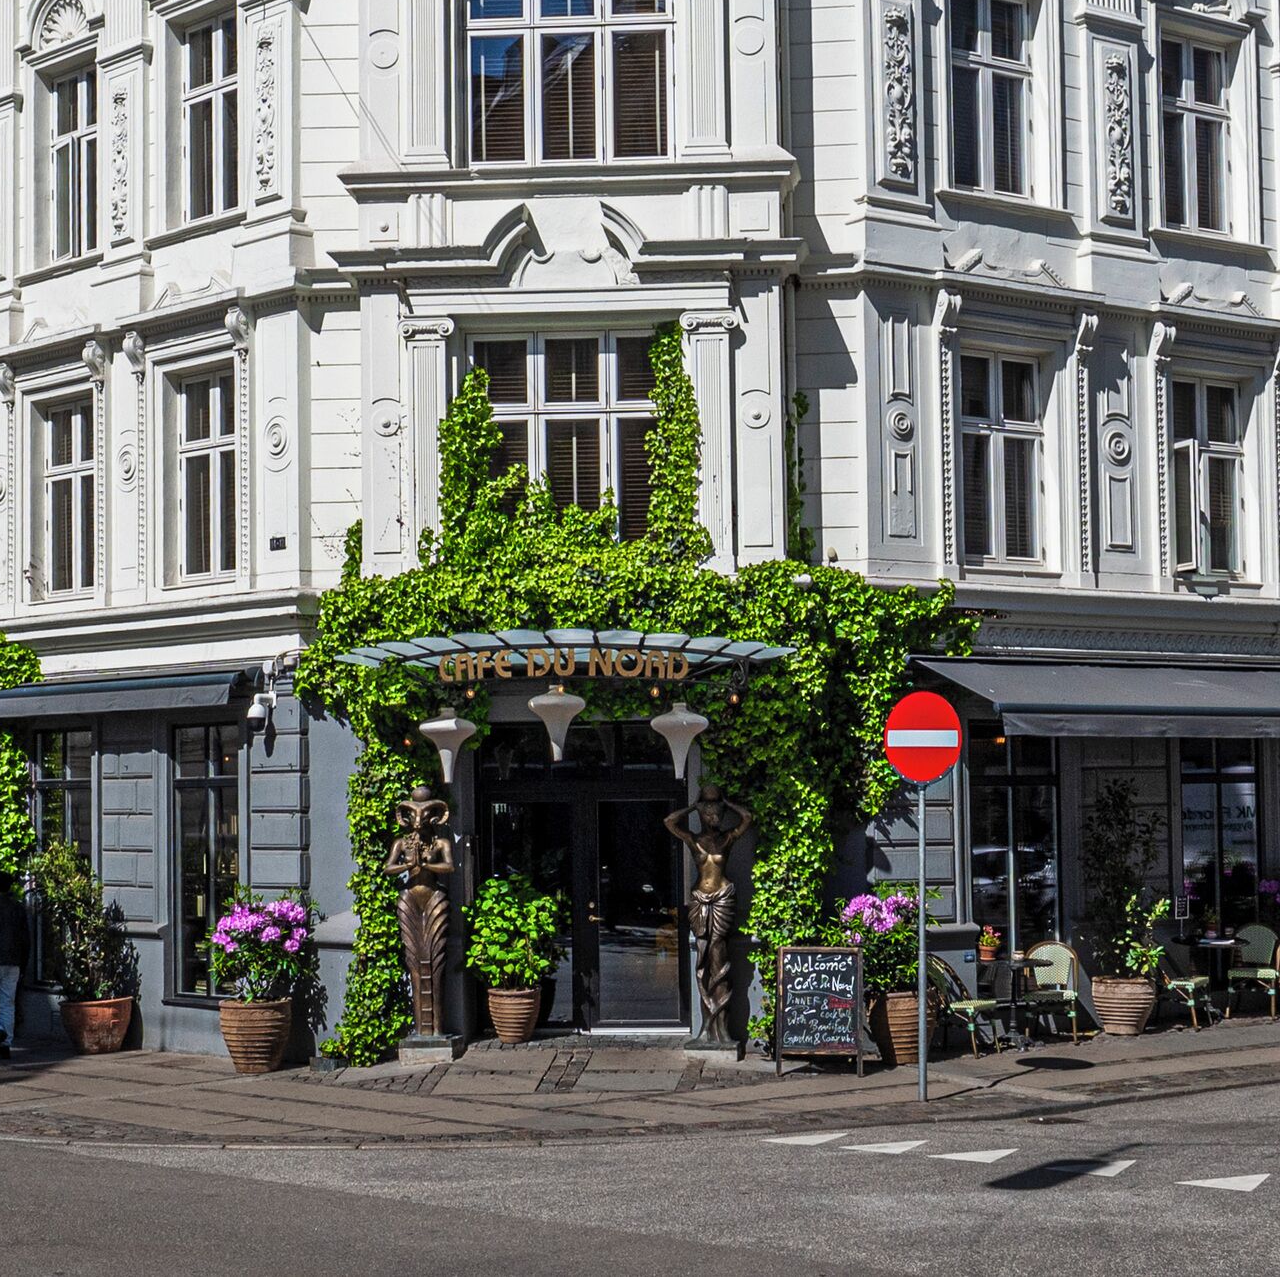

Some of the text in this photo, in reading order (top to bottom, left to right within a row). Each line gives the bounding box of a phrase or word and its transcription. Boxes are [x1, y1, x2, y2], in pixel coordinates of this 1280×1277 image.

[438, 647, 689, 682] CAFE DU NORD
